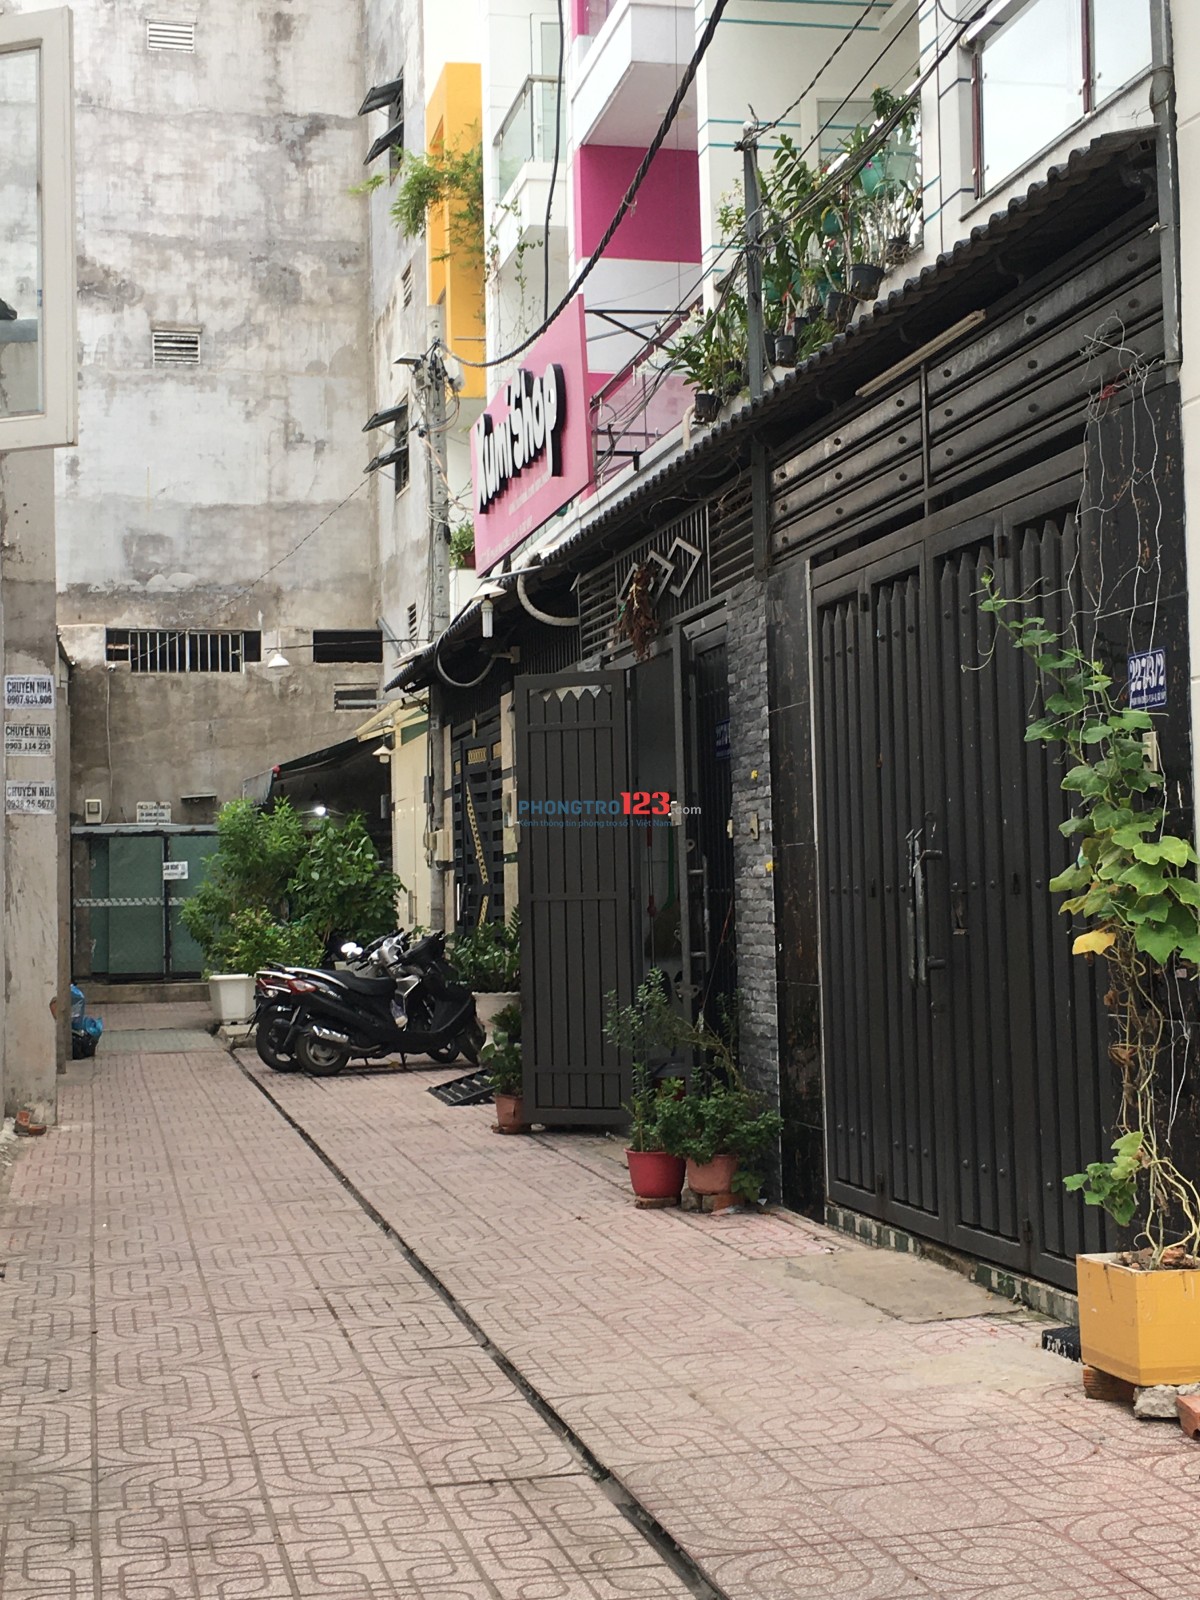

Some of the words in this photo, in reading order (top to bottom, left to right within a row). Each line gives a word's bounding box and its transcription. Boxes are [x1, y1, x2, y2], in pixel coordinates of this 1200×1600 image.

[5, 742, 22, 750] 0903
[24, 742, 37, 750] 114
[38, 742, 51, 750] 239
